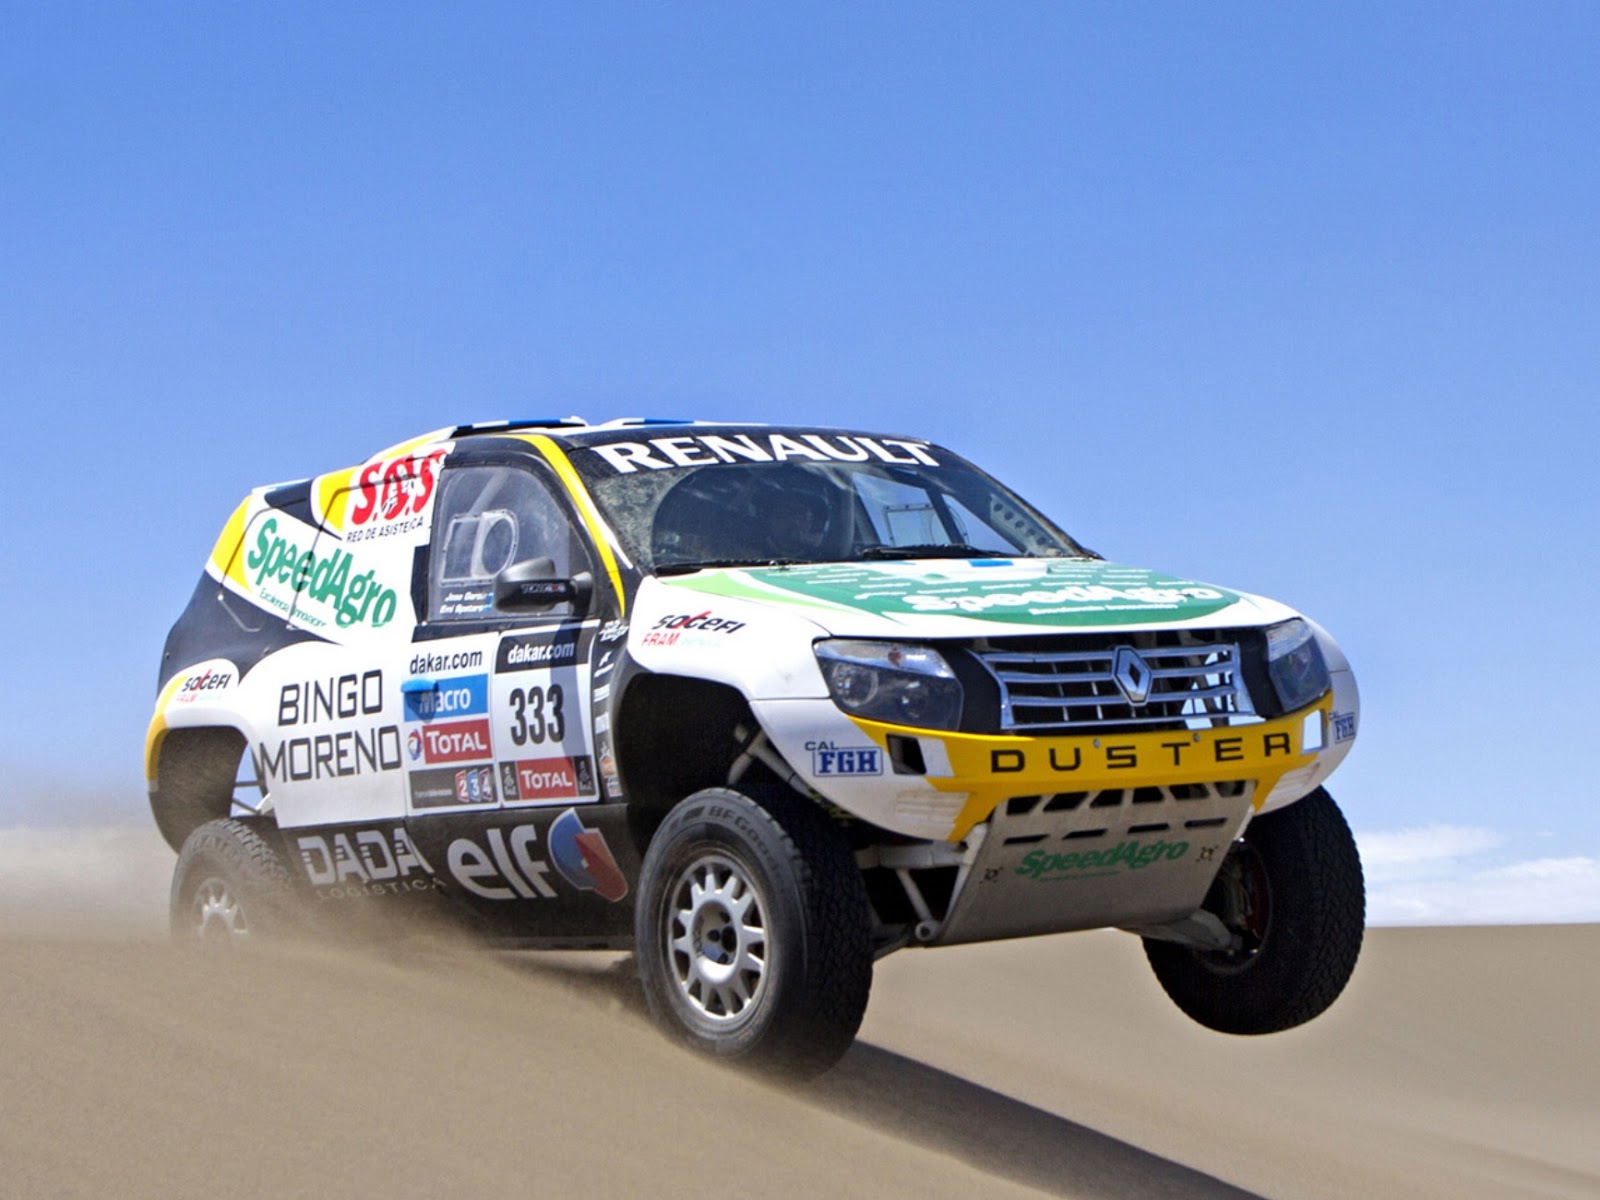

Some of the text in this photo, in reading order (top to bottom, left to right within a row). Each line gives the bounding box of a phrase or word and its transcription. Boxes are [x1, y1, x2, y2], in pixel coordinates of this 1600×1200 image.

[590, 433, 941, 475] RENAULT
[346, 530, 364, 543] RED
[365, 527, 378, 540] DE
[247, 517, 397, 628] SpeedAgro
[902, 585, 1227, 612] SpeedAgro
[641, 633, 681, 646] FRAM
[410, 651, 483, 674] dakar.com
[507, 643, 575, 665] dakar.com
[278, 669, 383, 726] BINGO
[419, 687, 472, 713] Macro
[509, 684, 566, 746] 333
[259, 724, 401, 783] MORENO
[426, 730, 488, 755] TOTAL
[804, 741, 839, 751] CAL
[991, 732, 1291, 773] DUSTER
[818, 750, 879, 774] FGH
[520, 769, 573, 789] TOTAL
[297, 827, 435, 886] DADA
[447, 824, 559, 900] elf
[1014, 839, 1190, 879] SpeedAgro
